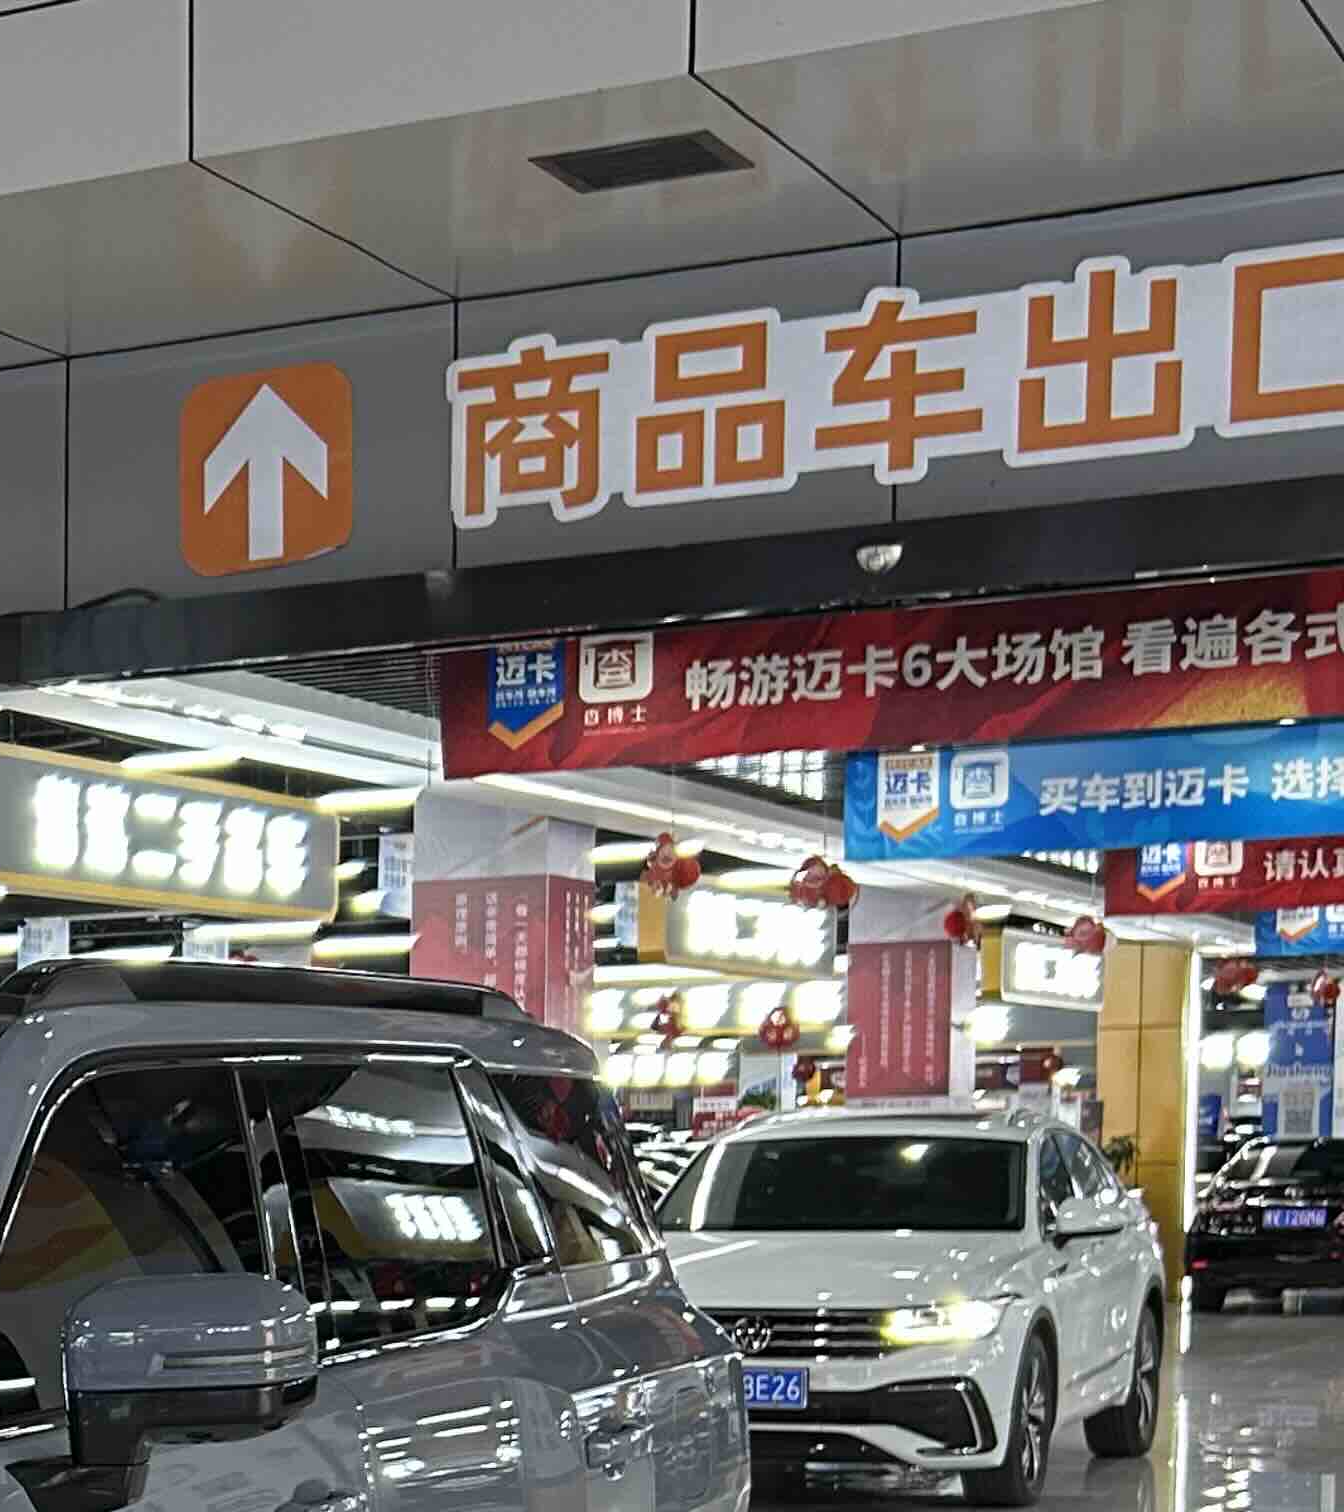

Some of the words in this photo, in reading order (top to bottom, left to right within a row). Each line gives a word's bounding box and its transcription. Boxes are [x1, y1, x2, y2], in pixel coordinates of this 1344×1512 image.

[448, 240, 1344, 524] 商品车出口
[495, 653, 557, 688] 迈卡
[684, 625, 1105, 712] 畅游迈卡6大场馆
[1120, 604, 1344, 677] 看遍各式
[1039, 768, 1249, 814] 买车到迈卡
